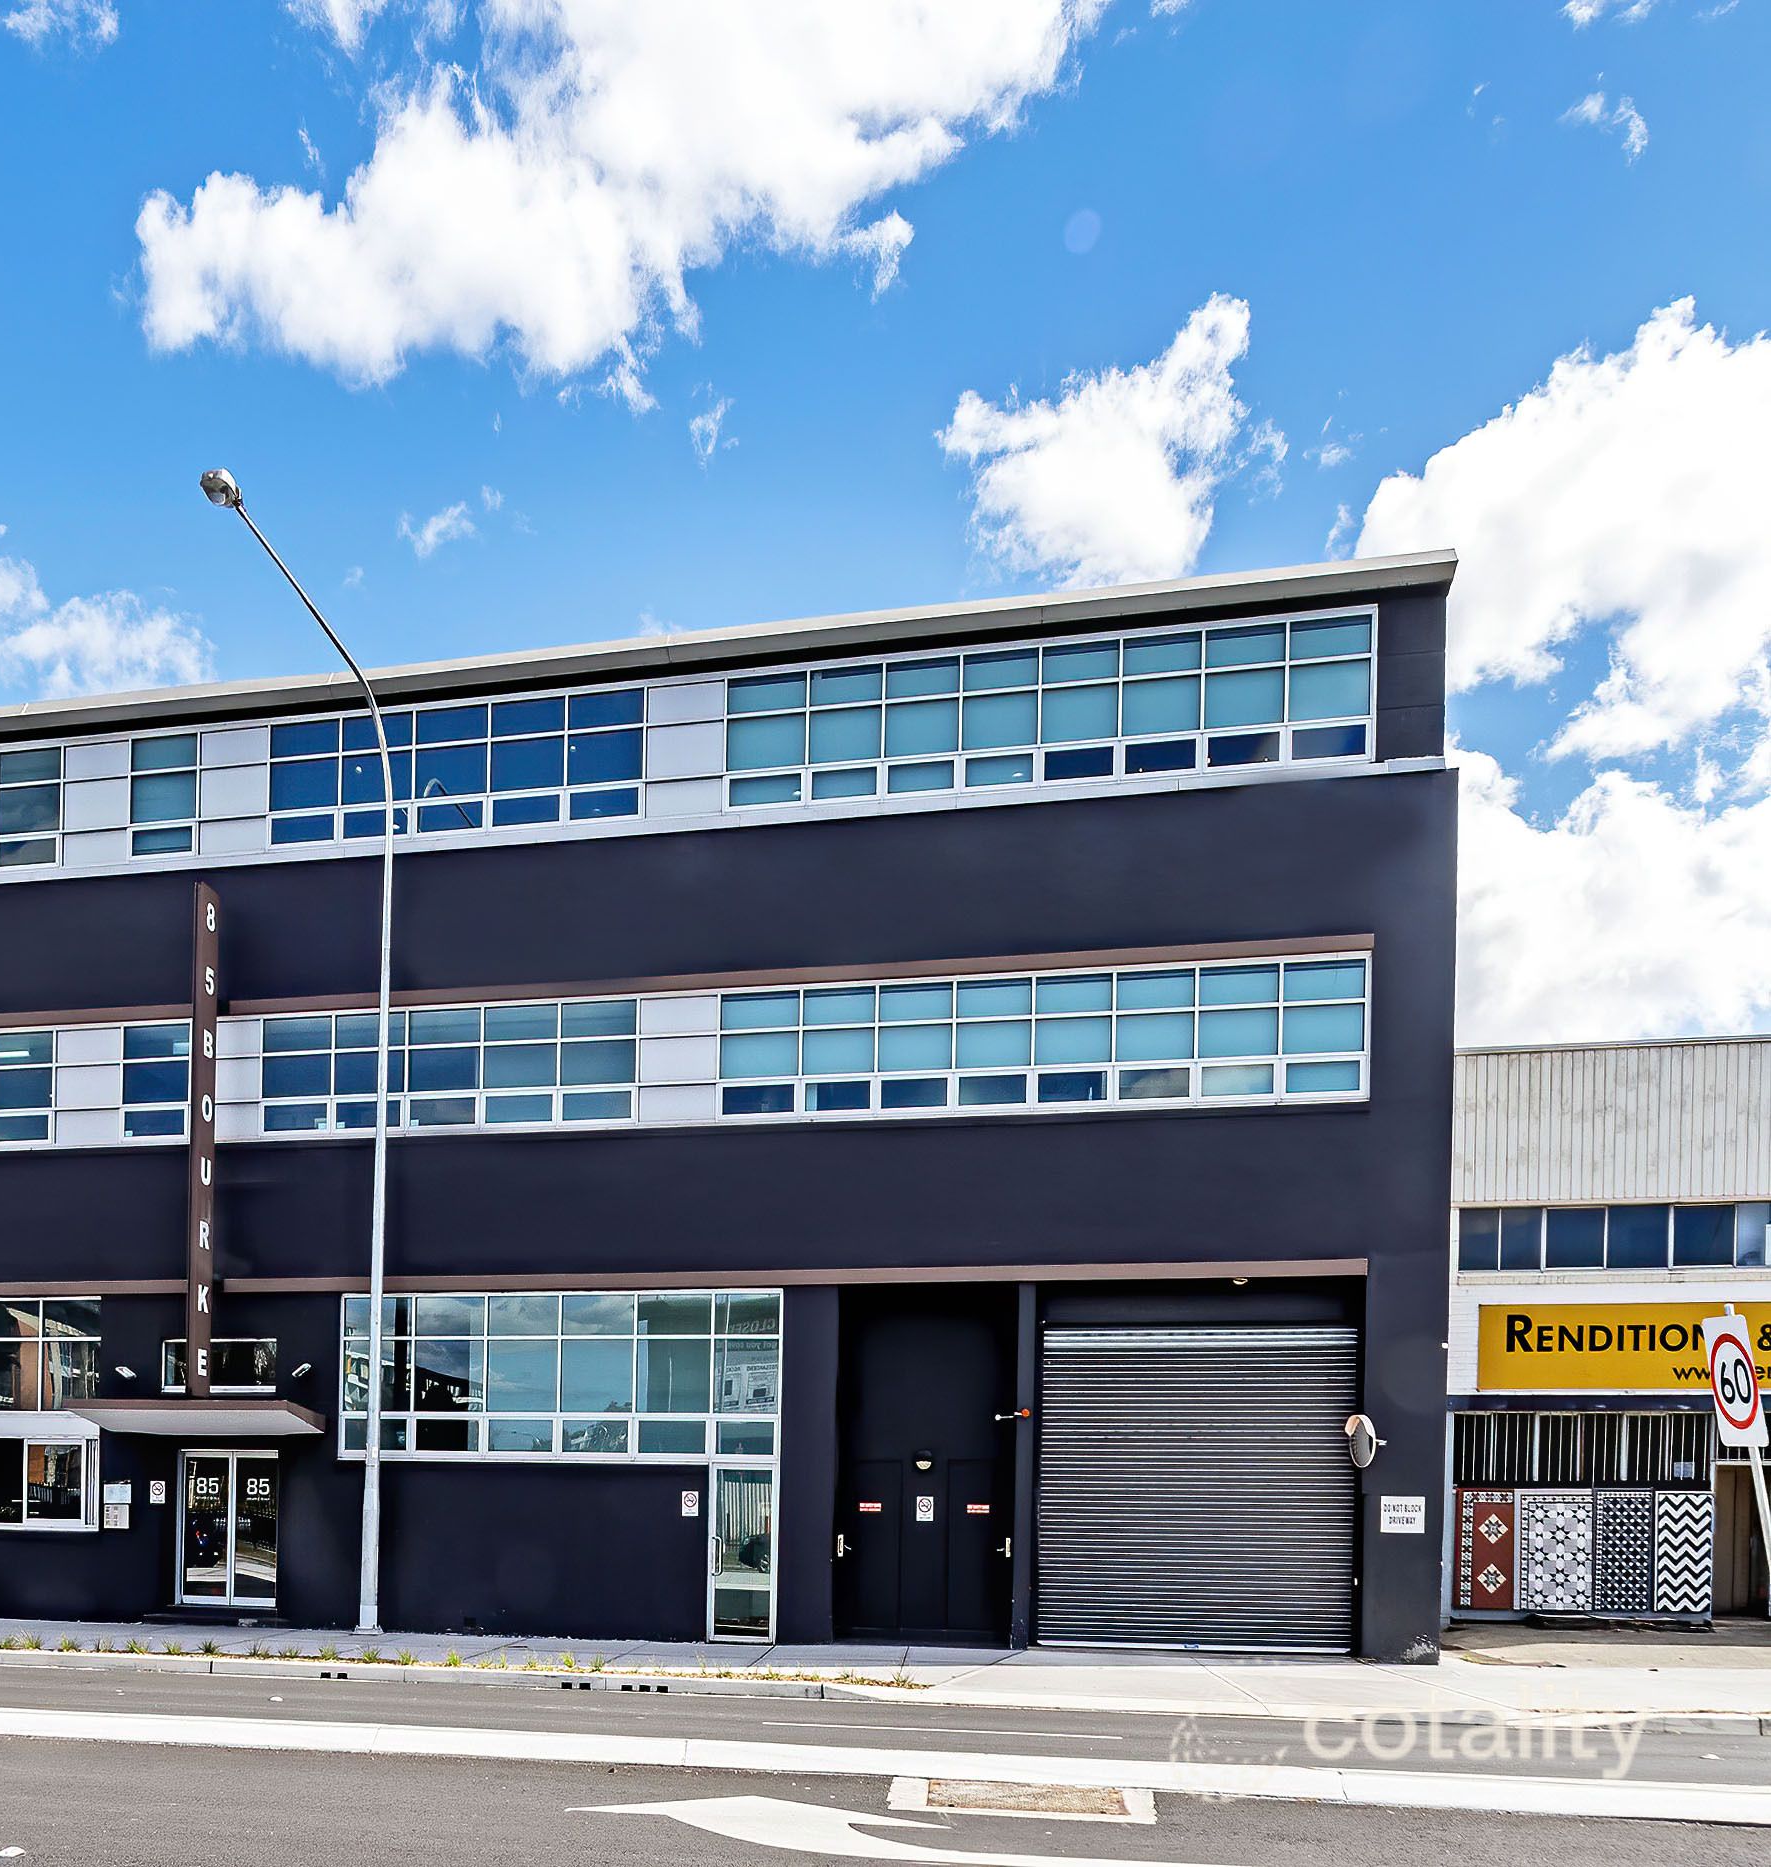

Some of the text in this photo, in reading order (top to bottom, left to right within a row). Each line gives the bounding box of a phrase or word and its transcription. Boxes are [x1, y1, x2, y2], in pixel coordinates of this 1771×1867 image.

[197, 1028, 214, 1377] BOURKE
[1721, 1358, 1751, 1404] 60
[196, 1477, 219, 1494] 85
[246, 1478, 270, 1495] 85
